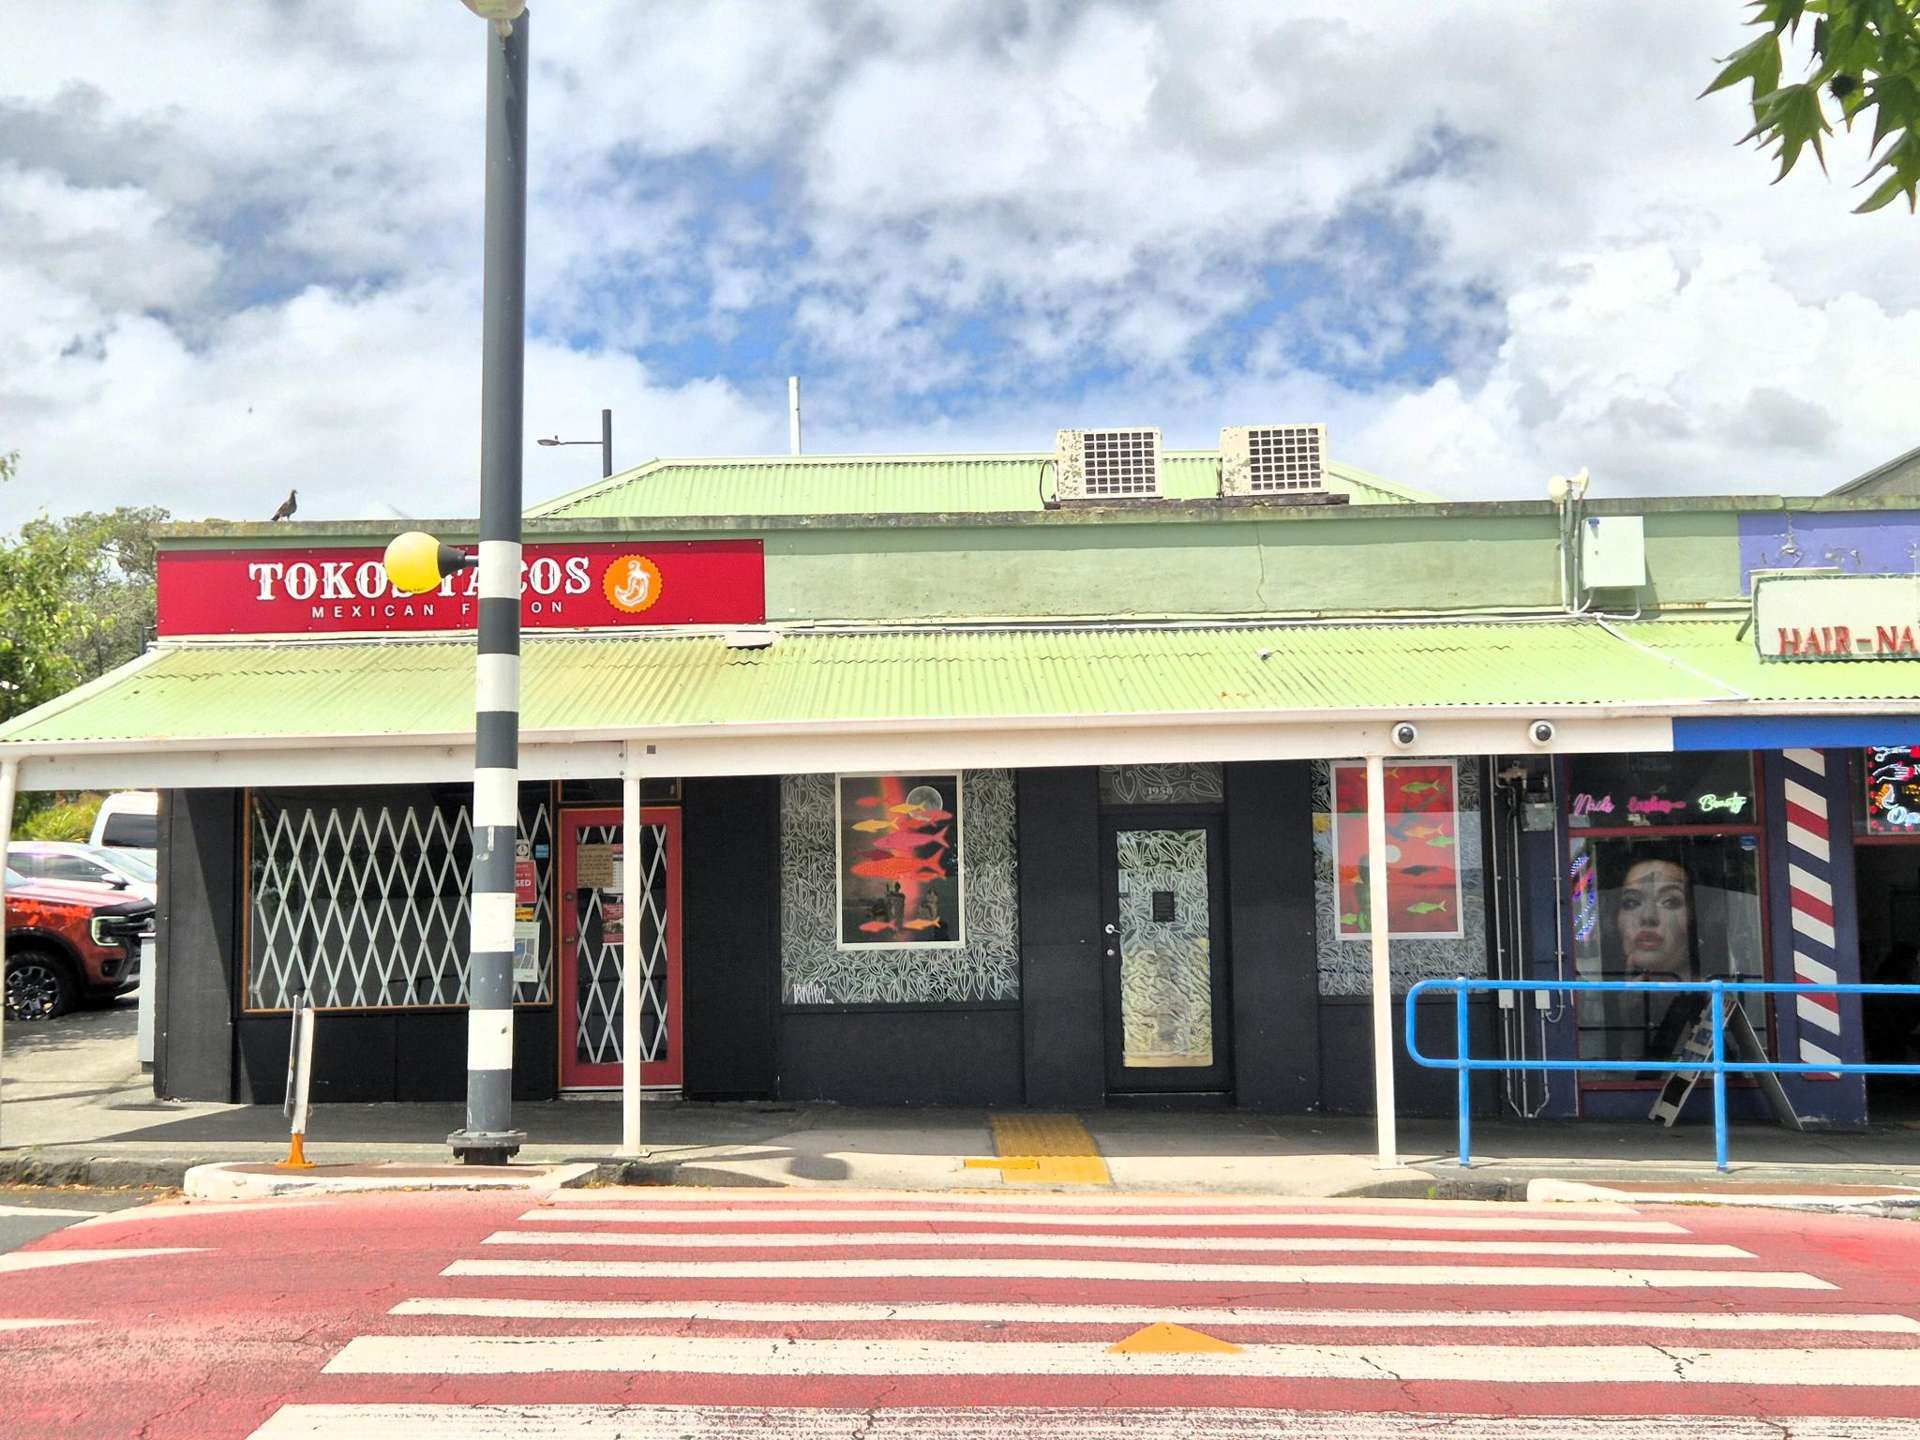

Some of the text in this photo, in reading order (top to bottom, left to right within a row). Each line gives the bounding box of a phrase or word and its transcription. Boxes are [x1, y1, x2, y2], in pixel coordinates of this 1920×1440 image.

[249, 561, 418, 600] TOKO
[311, 601, 562, 618] MEXICAN FON
[1777, 625, 1920, 656] HAIR-NA
[1698, 792, 1748, 814] Beauty
[514, 879, 532, 887] SED
